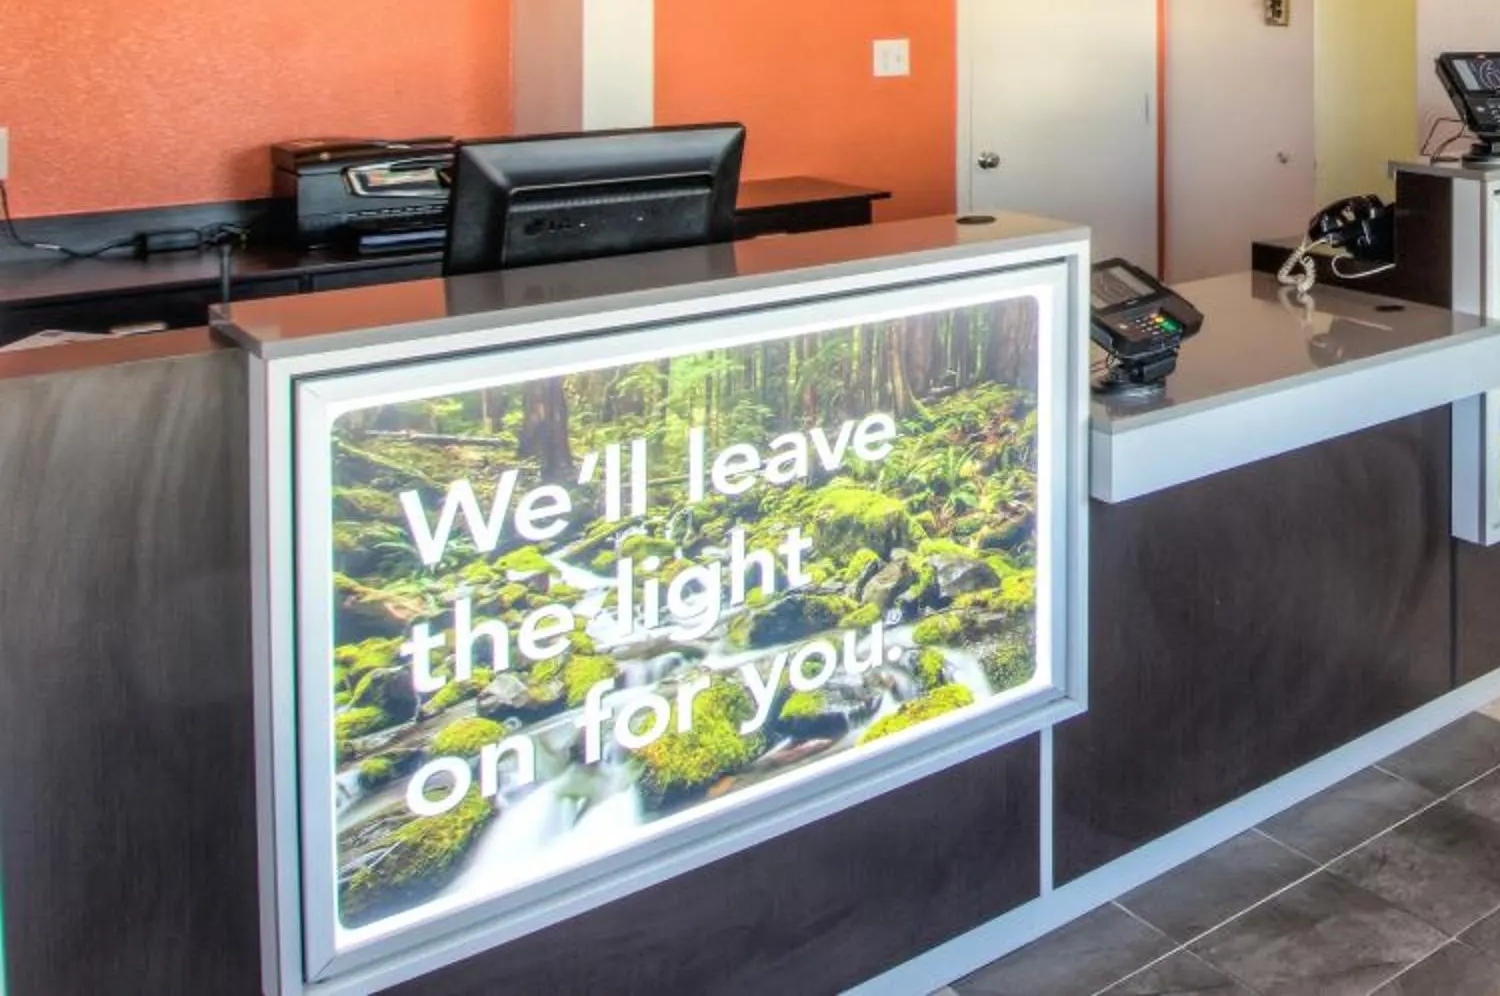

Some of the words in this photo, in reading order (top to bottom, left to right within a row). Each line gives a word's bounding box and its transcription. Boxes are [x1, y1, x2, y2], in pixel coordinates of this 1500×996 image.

[400, 438, 648, 570] We'll
[688, 411, 898, 503] leave
[400, 594, 576, 694] the
[616, 527, 814, 641] light
[405, 734, 537, 818] on
[579, 677, 712, 766] for
[739, 620, 904, 735] you.
